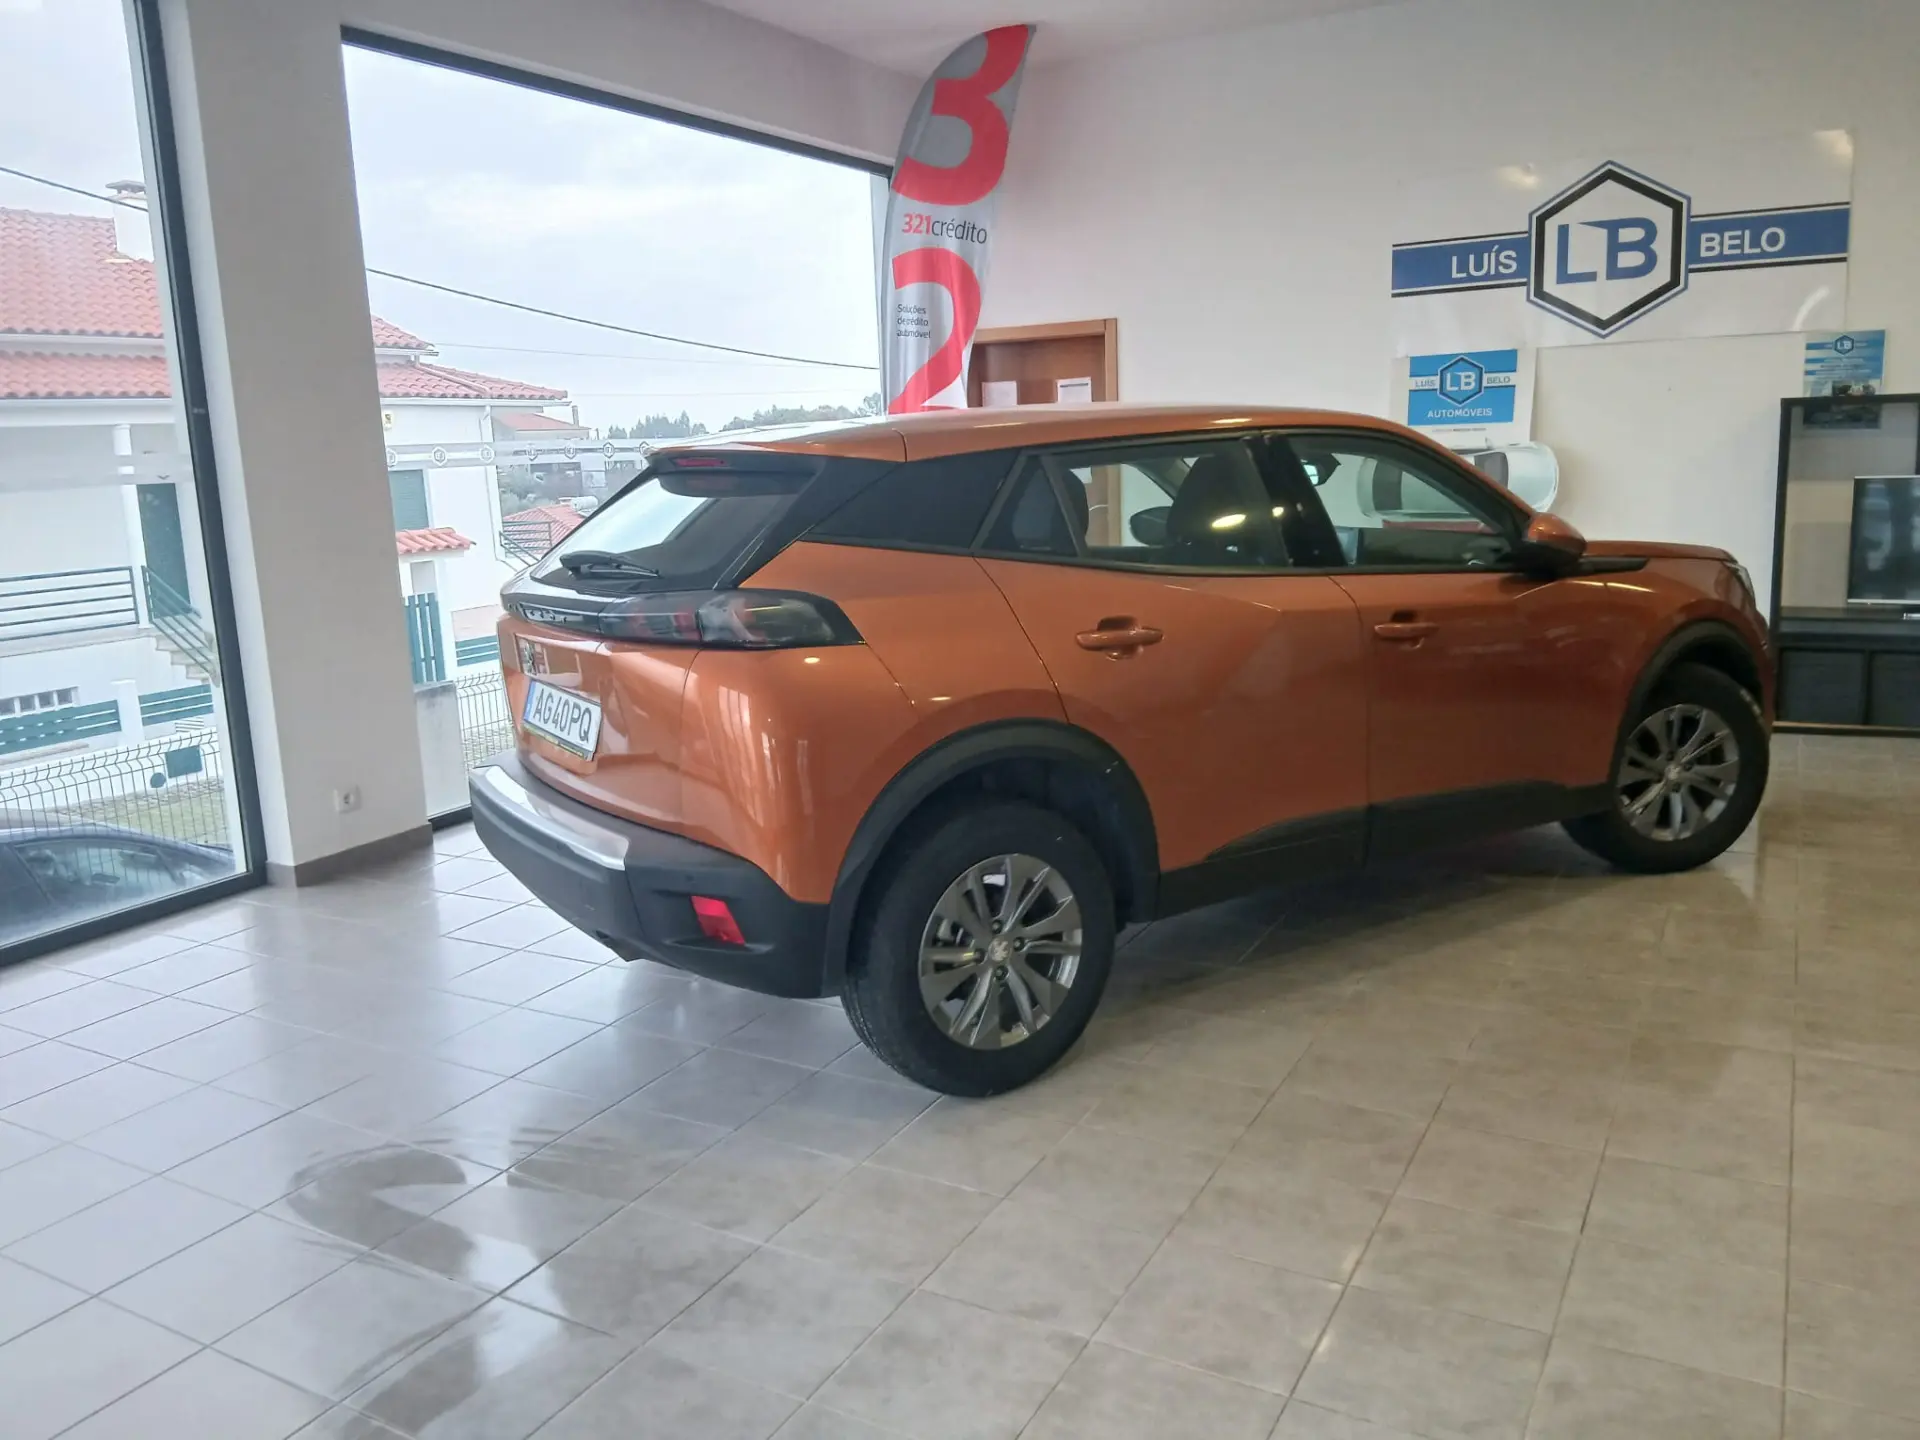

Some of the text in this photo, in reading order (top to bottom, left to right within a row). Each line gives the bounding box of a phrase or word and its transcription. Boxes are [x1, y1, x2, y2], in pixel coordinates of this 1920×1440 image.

[1451, 217, 1785, 284] LUÍS LB BELO
[1446, 371, 1476, 391] LB
[1486, 376, 1511, 385] BELO
